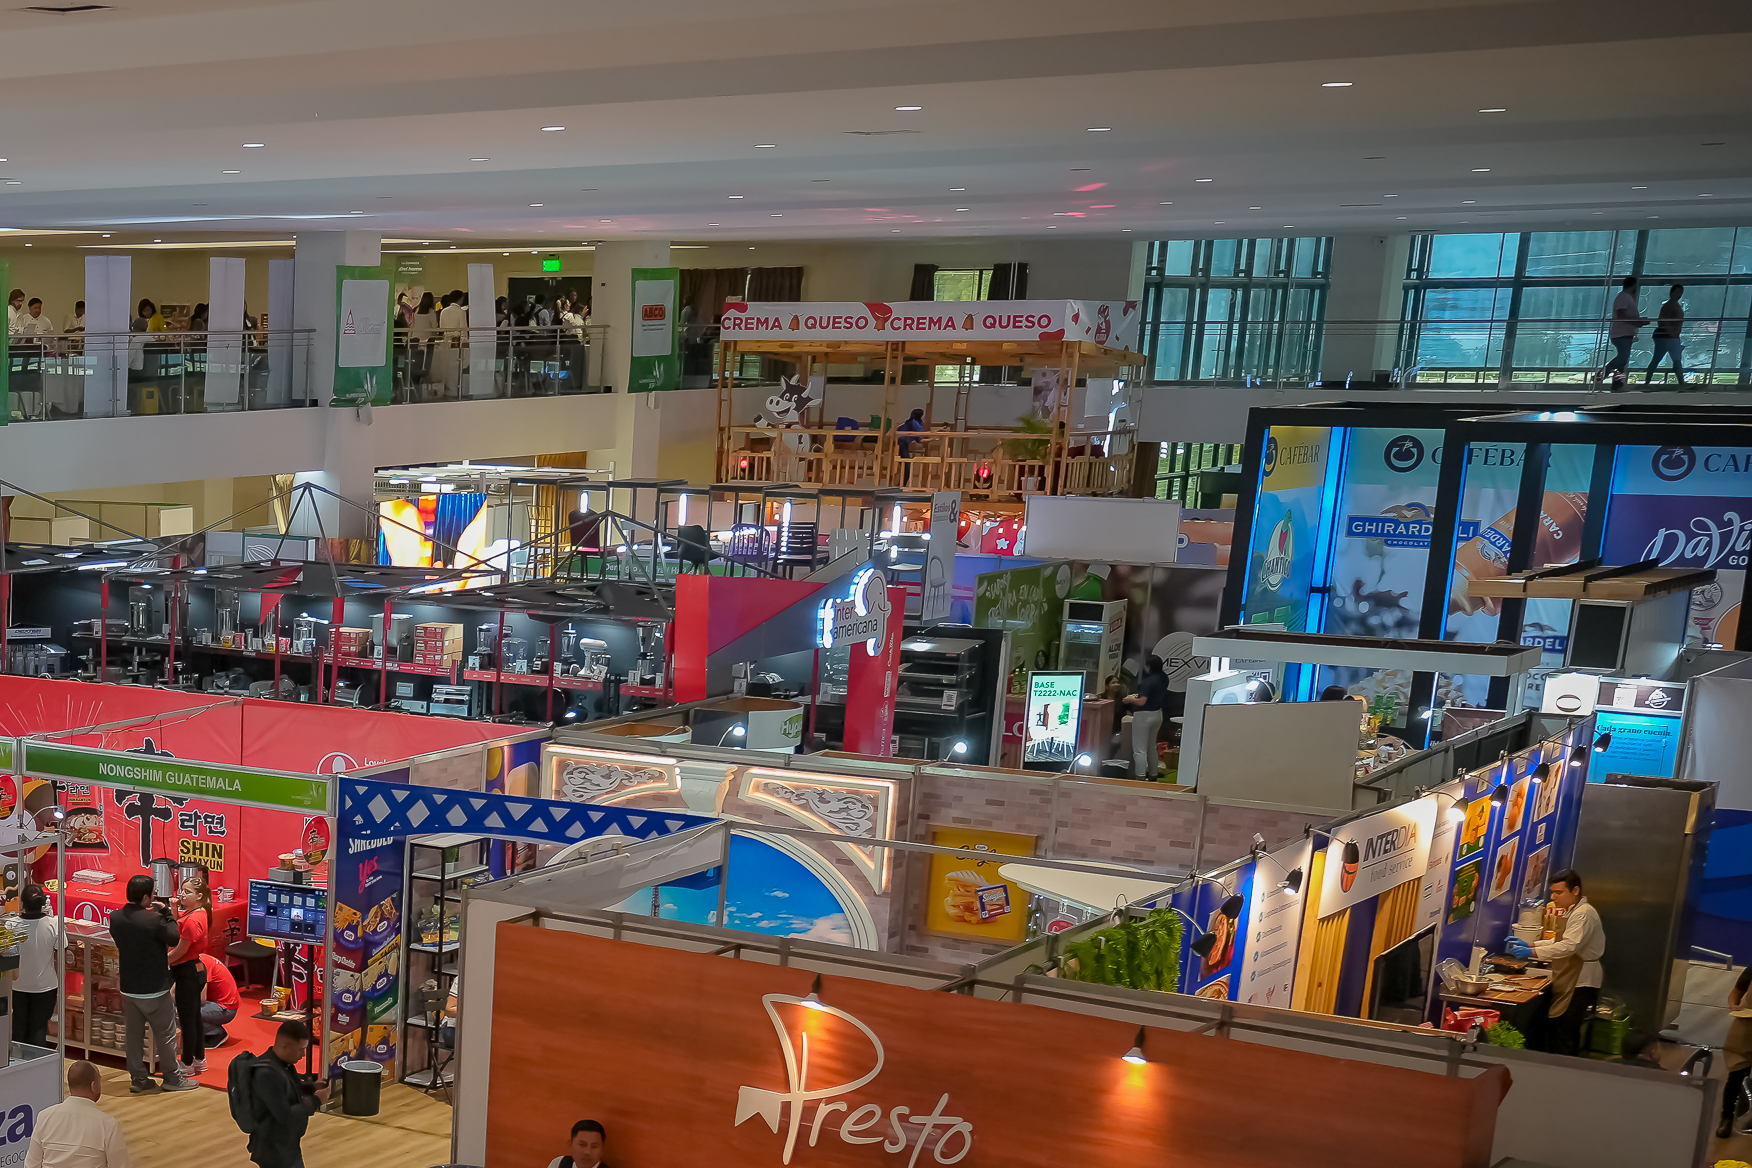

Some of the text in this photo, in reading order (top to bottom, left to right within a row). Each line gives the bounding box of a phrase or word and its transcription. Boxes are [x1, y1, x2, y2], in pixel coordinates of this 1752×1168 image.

[721, 313, 1053, 332] CREMA QUESO CREMA QUESO
[1279, 441, 1319, 467] CAFÉBAR
[834, 603, 854, 623] inter
[833, 616, 878, 640] americana
[1033, 688, 1078, 698] T2222-NAC
[1034, 681, 1056, 690] BASE
[1618, 725, 1642, 737] grano
[98, 761, 242, 793] NONGSHIM GUATEMALA
[179, 837, 225, 859] SHIN
[1363, 822, 1417, 863] INTERDIA
[358, 856, 379, 894] Yes
